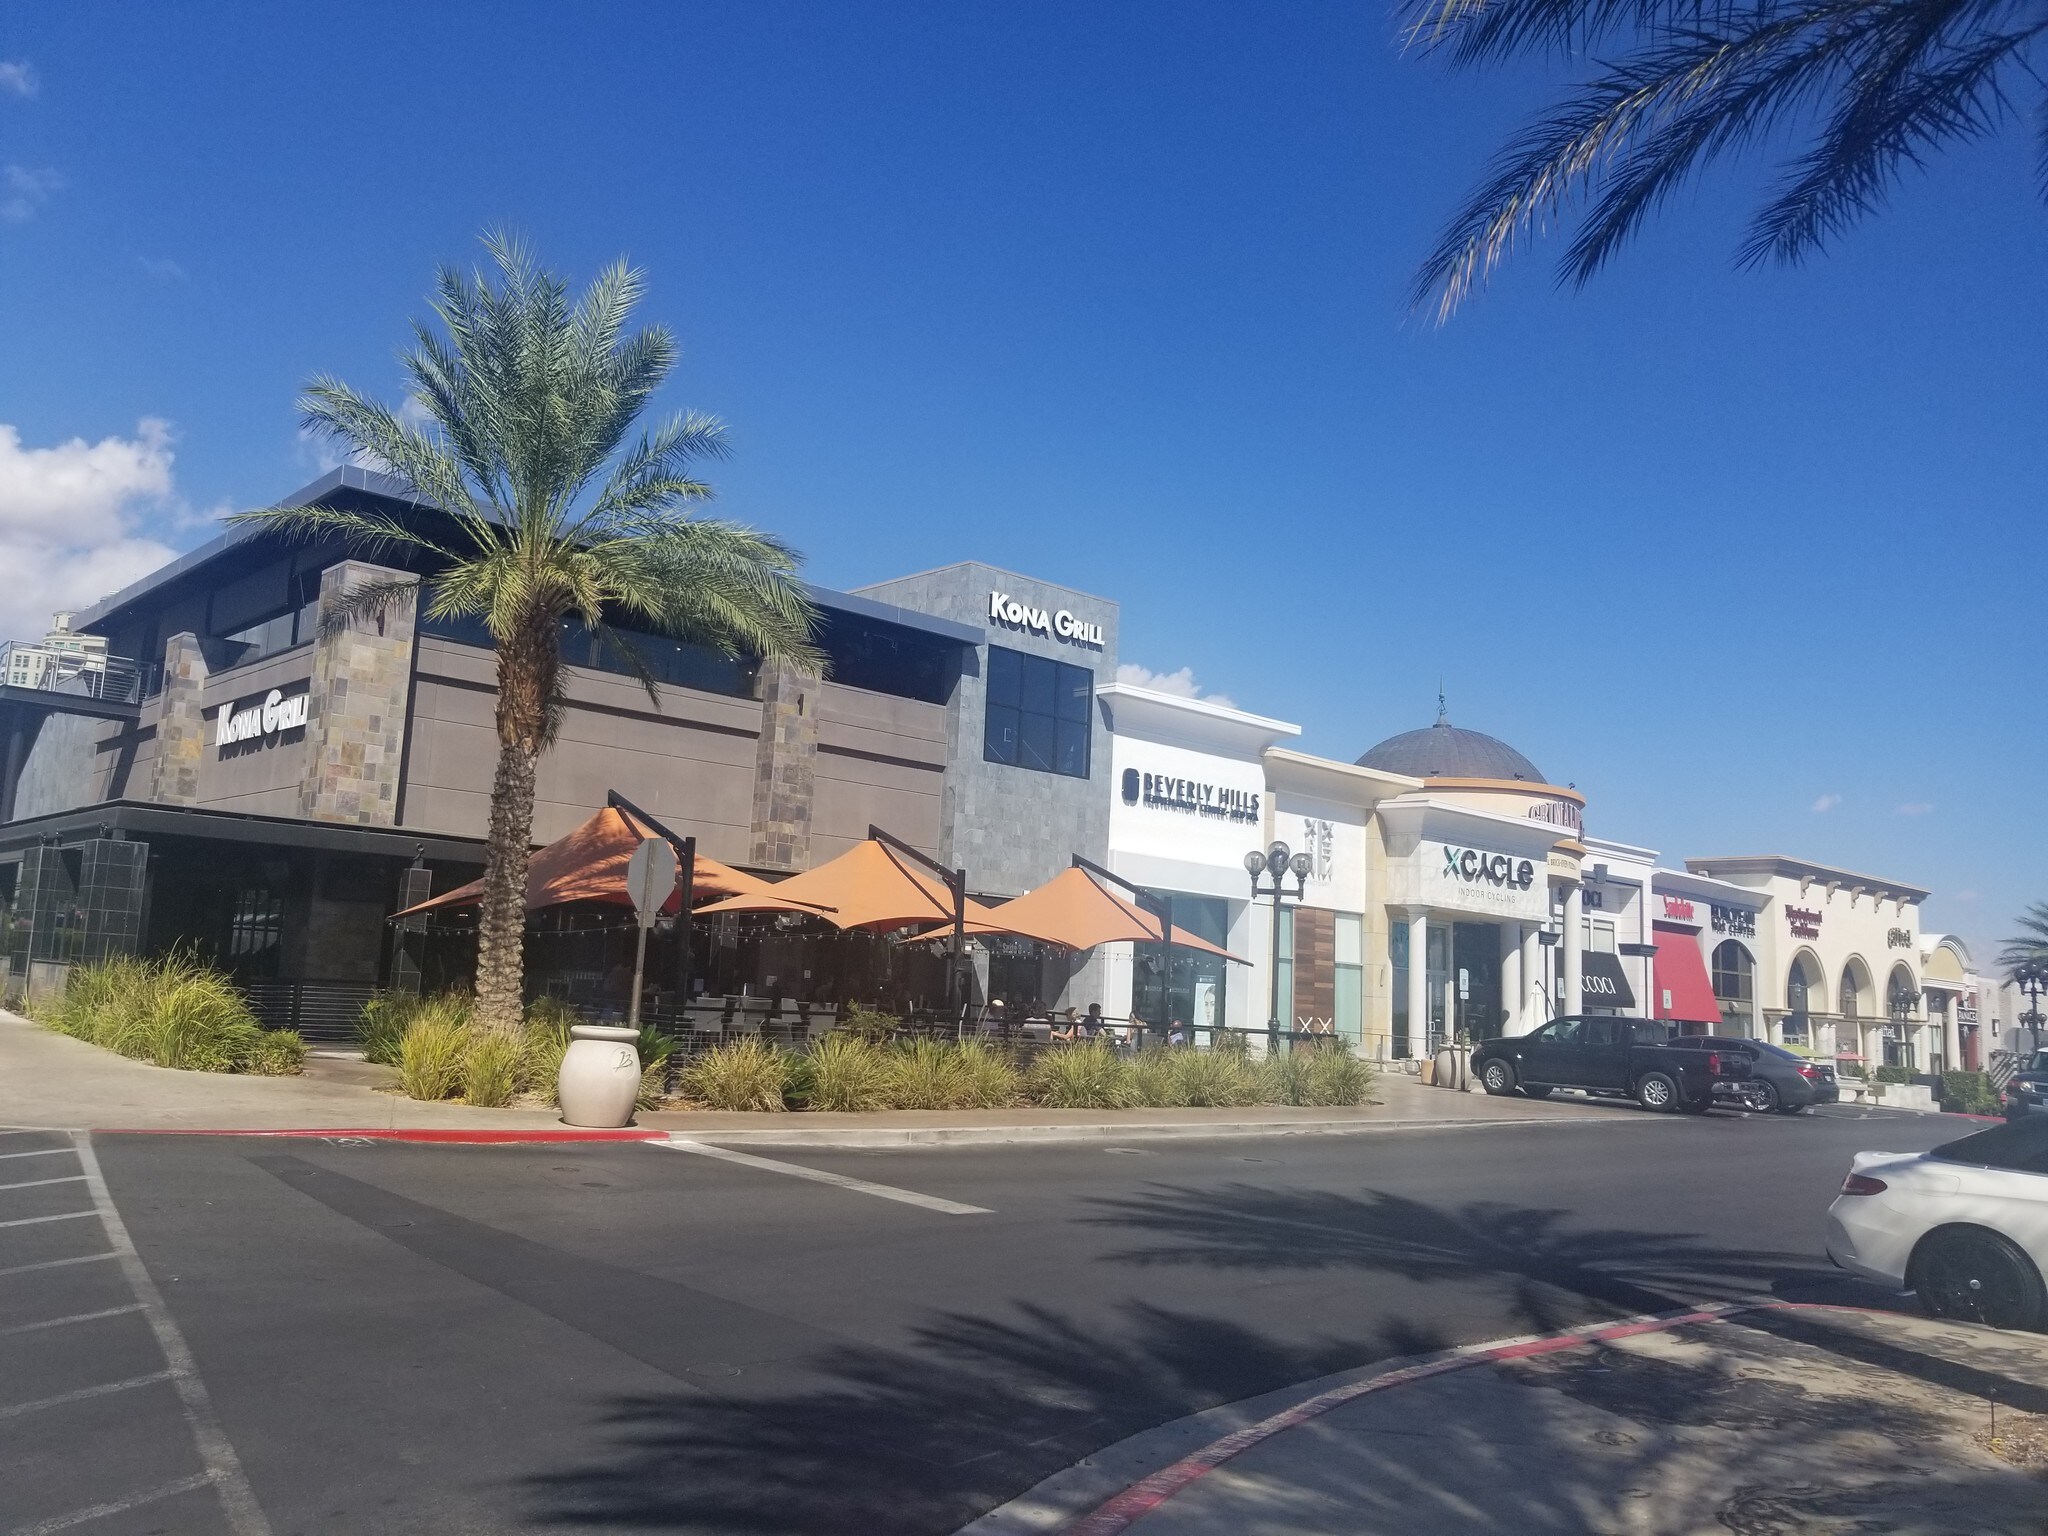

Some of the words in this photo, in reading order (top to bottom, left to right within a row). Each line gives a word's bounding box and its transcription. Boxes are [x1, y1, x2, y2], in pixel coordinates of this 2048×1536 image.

[991, 590, 1051, 632] KONA
[1054, 609, 1105, 646] GRILL
[216, 702, 262, 747] KONA
[1143, 772, 1224, 802] BEVERLY
[1218, 787, 1260, 811] HILLS
[1458, 887, 1485, 899] INDOOR
[1487, 891, 1516, 904] CYCLING
